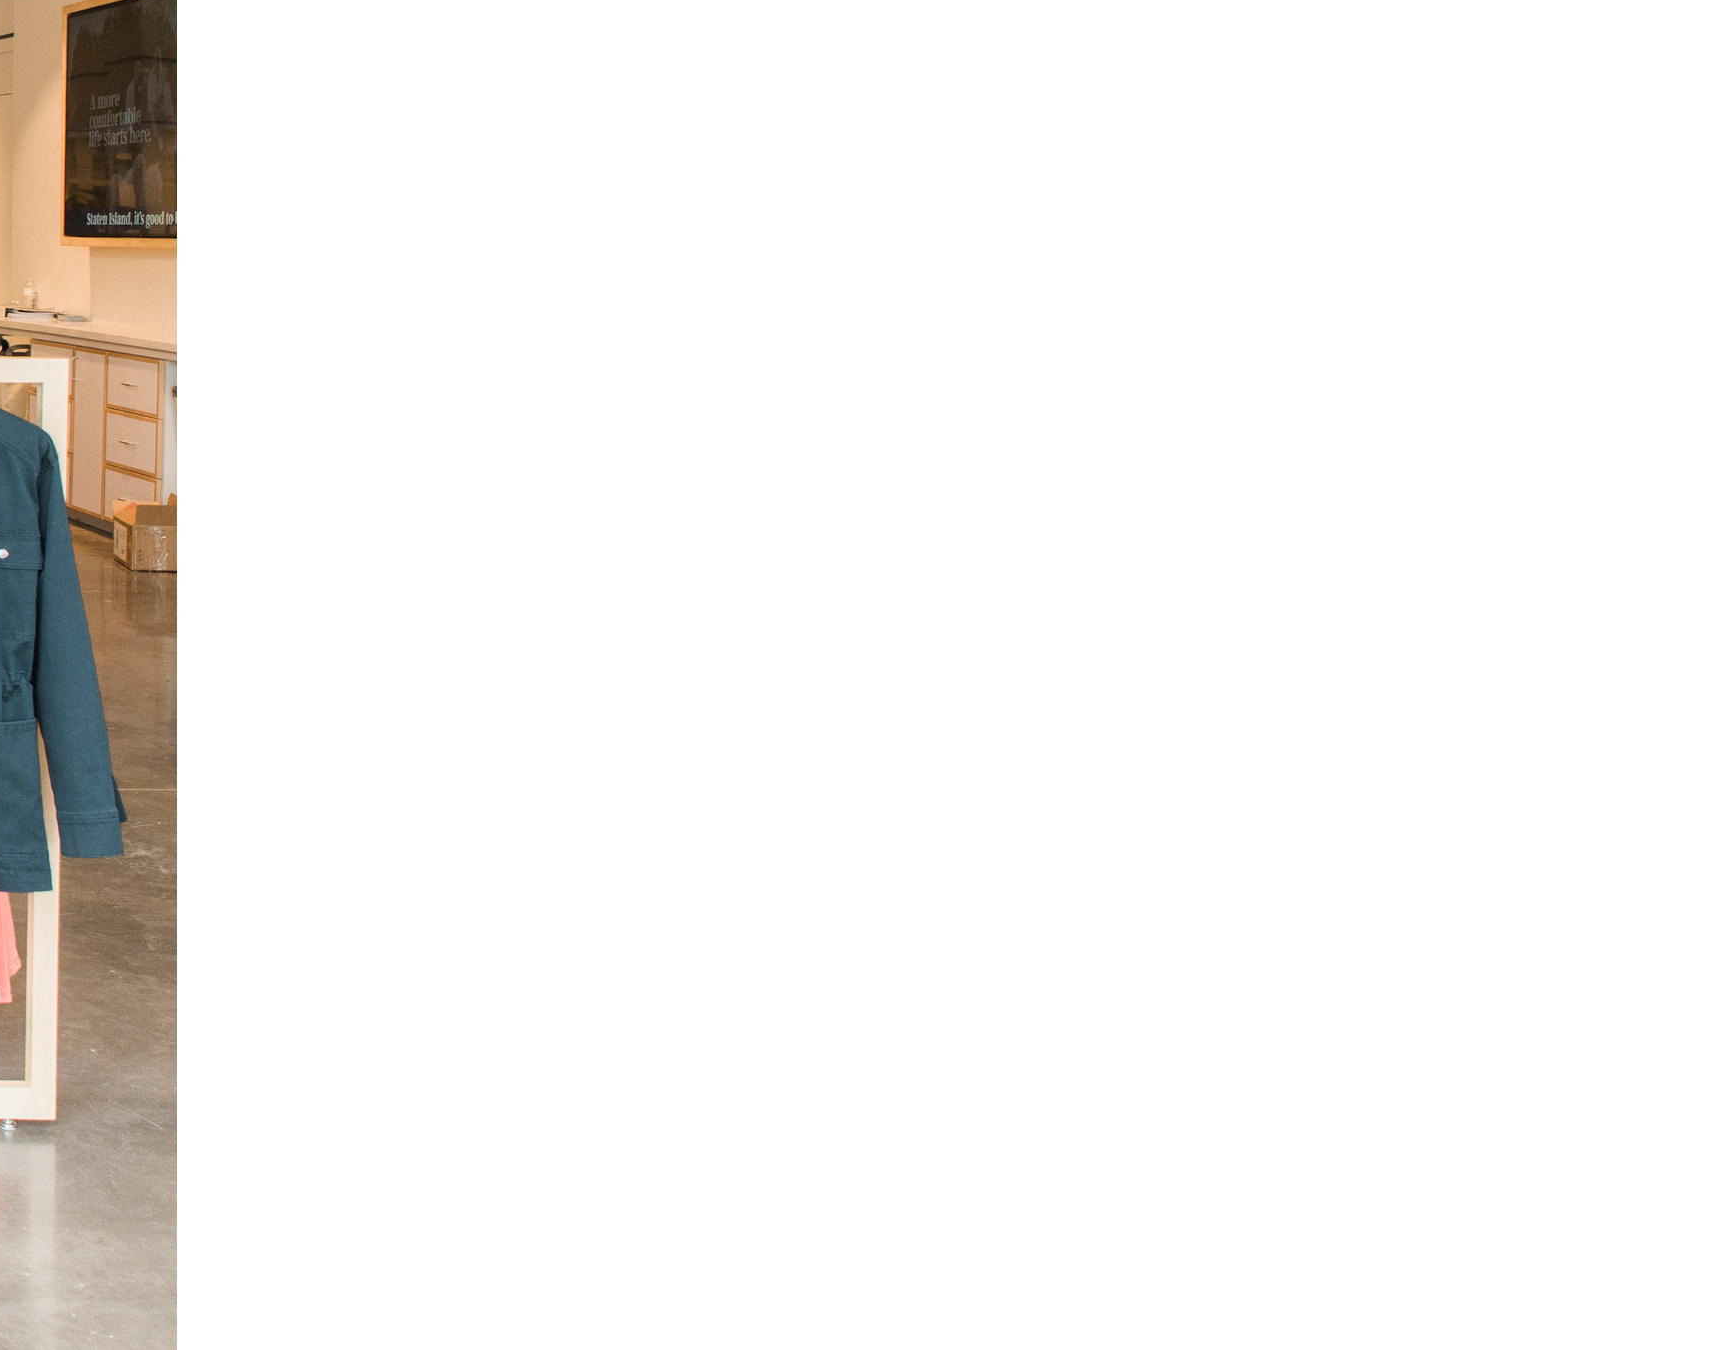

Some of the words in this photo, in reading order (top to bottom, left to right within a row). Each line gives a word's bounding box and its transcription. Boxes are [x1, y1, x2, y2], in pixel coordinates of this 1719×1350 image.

[90, 95, 96, 110] A
[98, 94, 120, 109] more
[89, 107, 141, 128] comfortable
[89, 130, 102, 147] life
[104, 128, 128, 146] starts
[129, 126, 152, 144] here.
[86, 212, 107, 225] Staten
[109, 211, 132, 226] Island,
[145, 211, 165, 228] good
[166, 212, 173, 225] to
